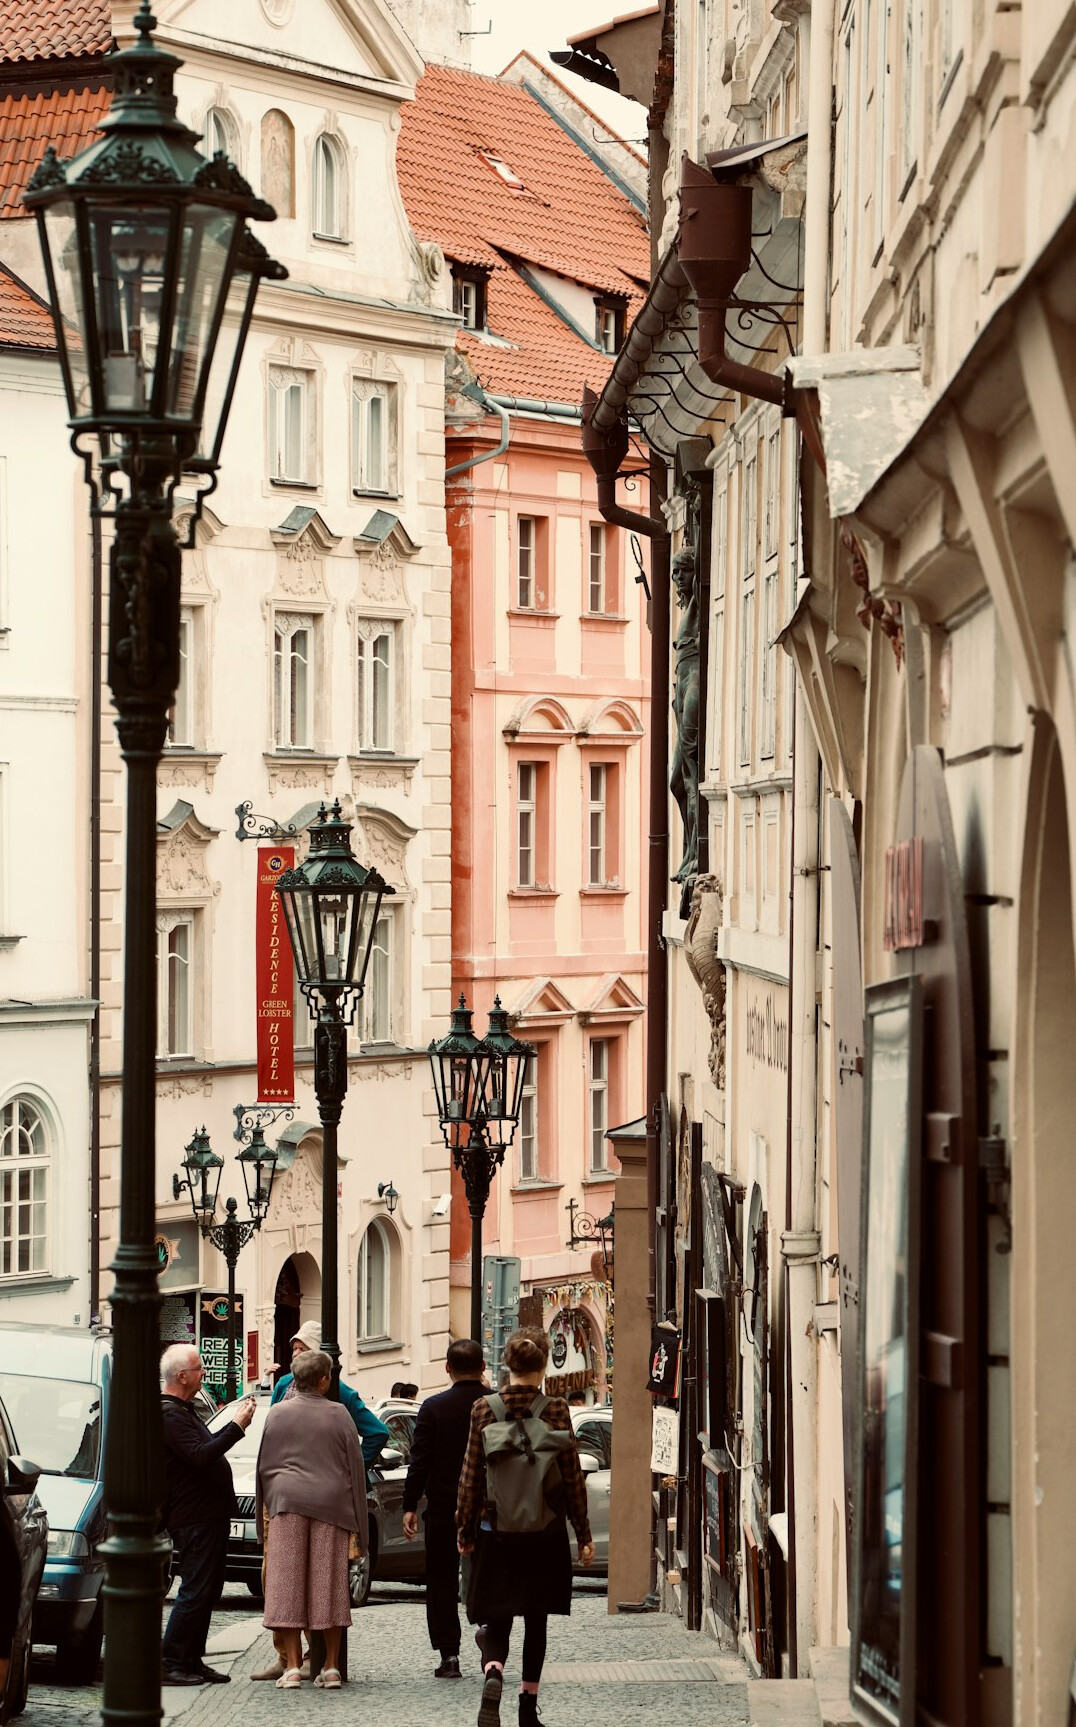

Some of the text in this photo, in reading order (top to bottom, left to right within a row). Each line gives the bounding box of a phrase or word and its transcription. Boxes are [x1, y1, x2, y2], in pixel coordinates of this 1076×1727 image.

[262, 1000, 288, 1009] GREEN
[258, 1009, 292, 1018] LOBSTER
[269, 1023, 280, 1080] HOTEL
